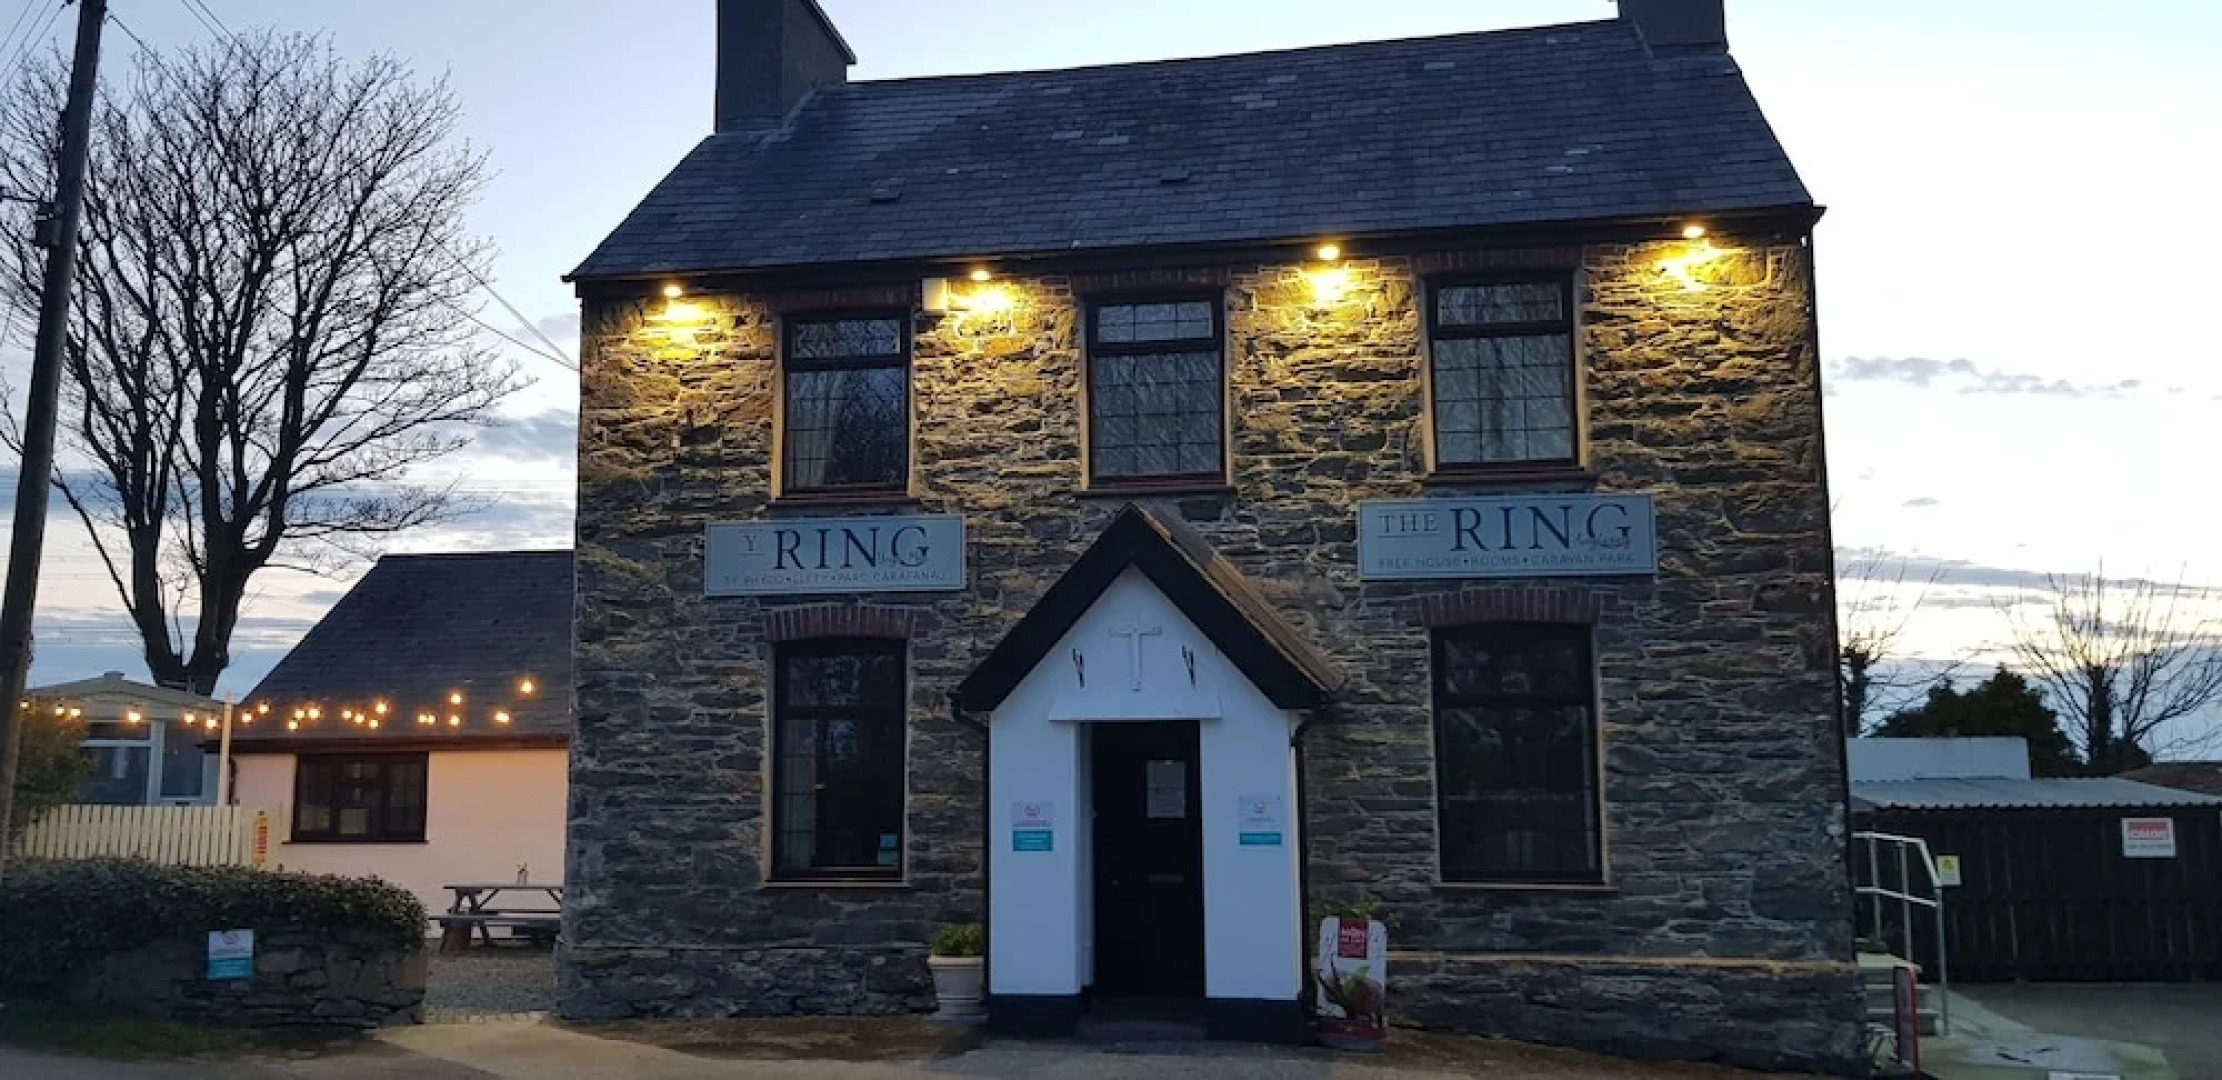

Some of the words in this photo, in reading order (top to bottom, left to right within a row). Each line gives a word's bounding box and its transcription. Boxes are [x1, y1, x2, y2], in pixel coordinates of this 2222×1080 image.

[742, 534, 757, 552] Y
[772, 525, 930, 569] RING
[1378, 513, 1438, 533] THE
[1449, 503, 1632, 551] RING
[1378, 557, 1408, 569] FREE
[1416, 556, 1460, 568] HOUSE
[1471, 554, 1520, 566] ROOMS
[1530, 553, 1593, 565] CARAVAN
[1600, 552, 1632, 562] PARK
